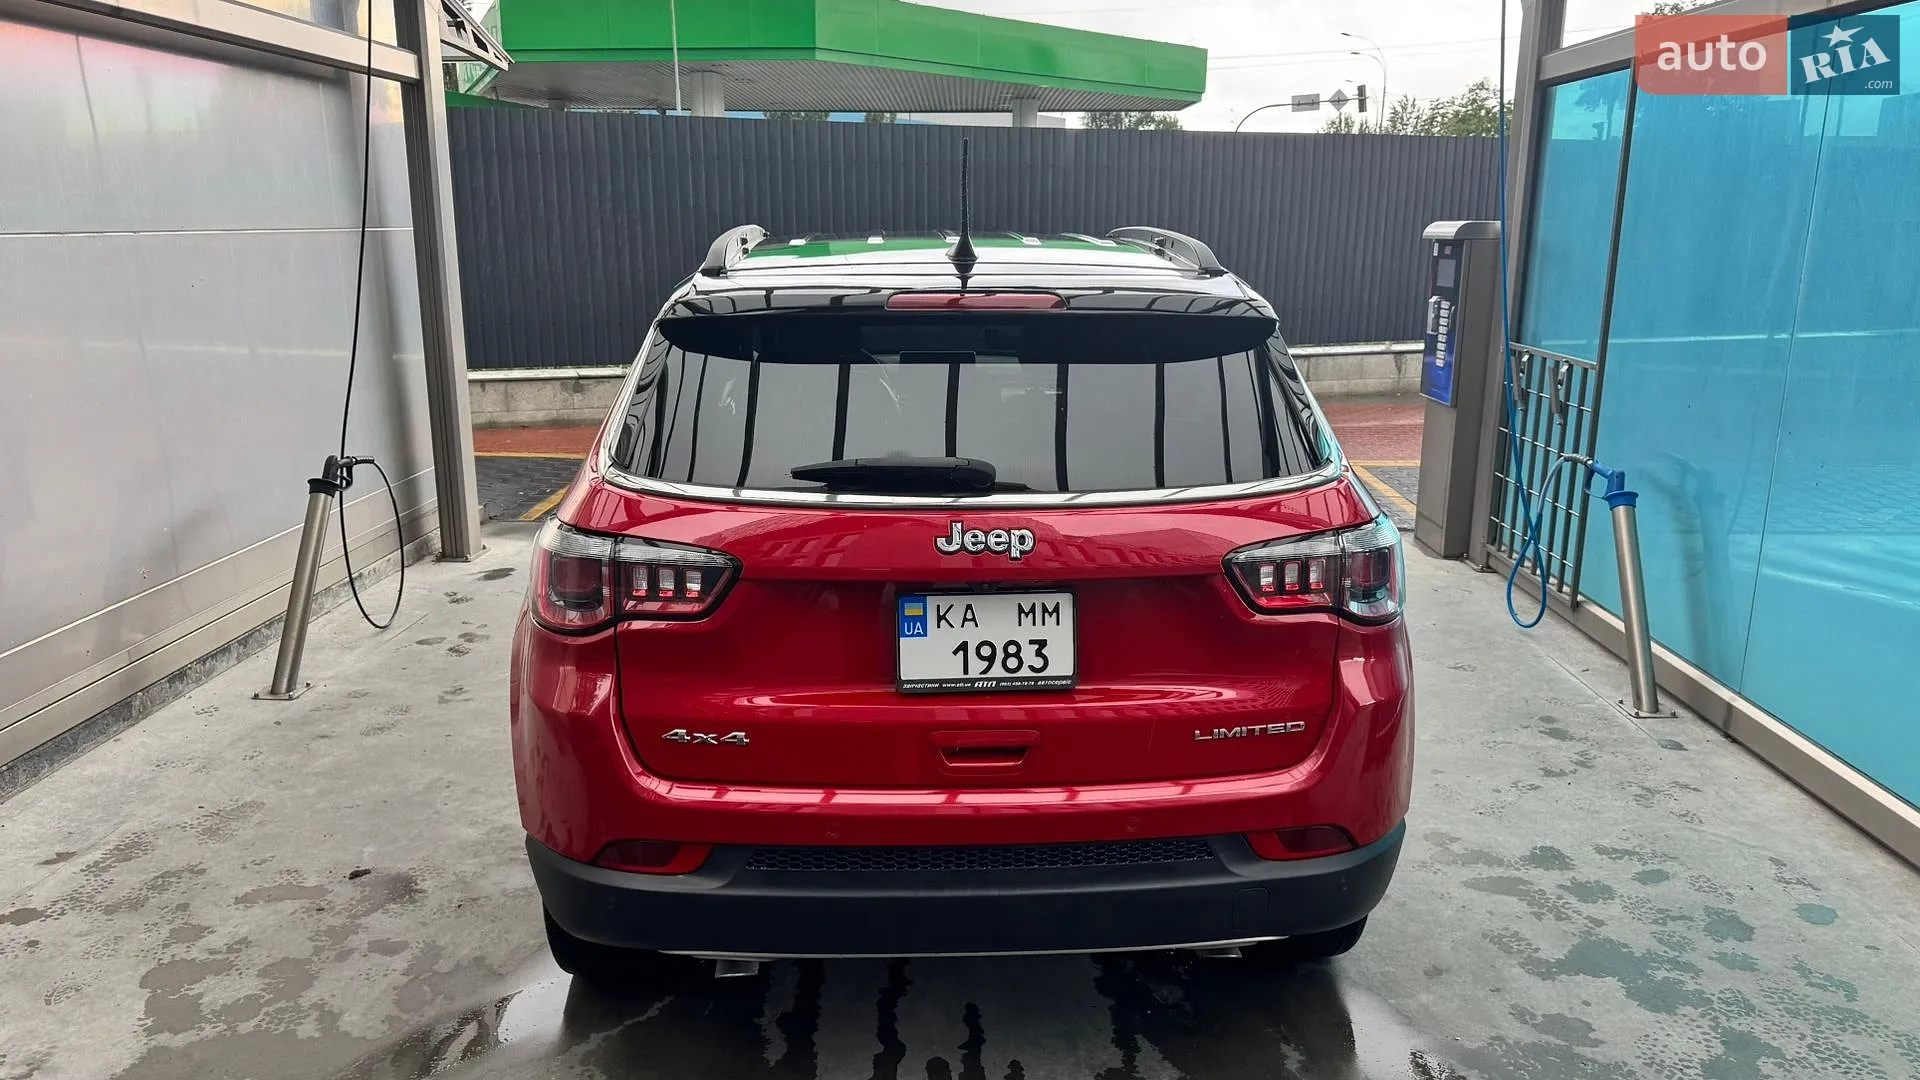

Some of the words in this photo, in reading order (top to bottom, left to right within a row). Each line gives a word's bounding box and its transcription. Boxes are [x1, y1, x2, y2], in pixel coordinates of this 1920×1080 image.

[935, 521, 1035, 559] Jeep
[904, 622, 924, 635] UA
[936, 603, 979, 629] KA
[1017, 602, 1060, 627] MM
[951, 639, 1050, 675] 1983
[1194, 721, 1306, 741] LIMITED
